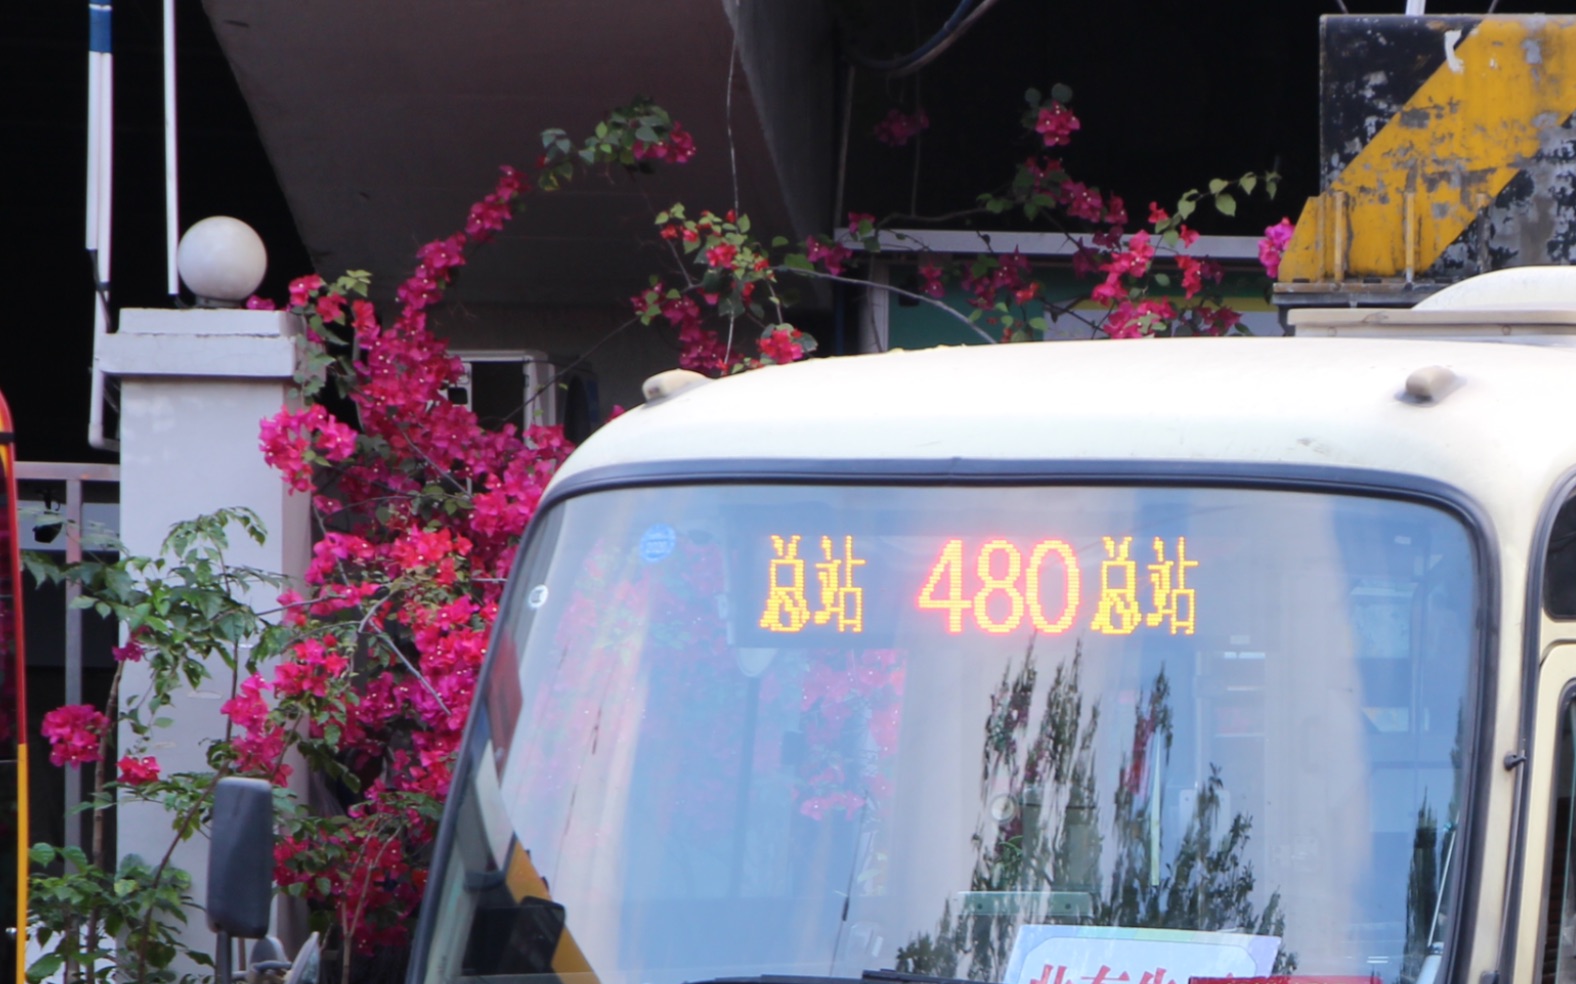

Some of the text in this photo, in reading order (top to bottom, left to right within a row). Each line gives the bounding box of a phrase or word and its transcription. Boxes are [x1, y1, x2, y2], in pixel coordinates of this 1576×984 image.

[759, 534, 866, 633] 总站
[915, 538, 1083, 634] 480
[1090, 535, 1199, 635] 总站
